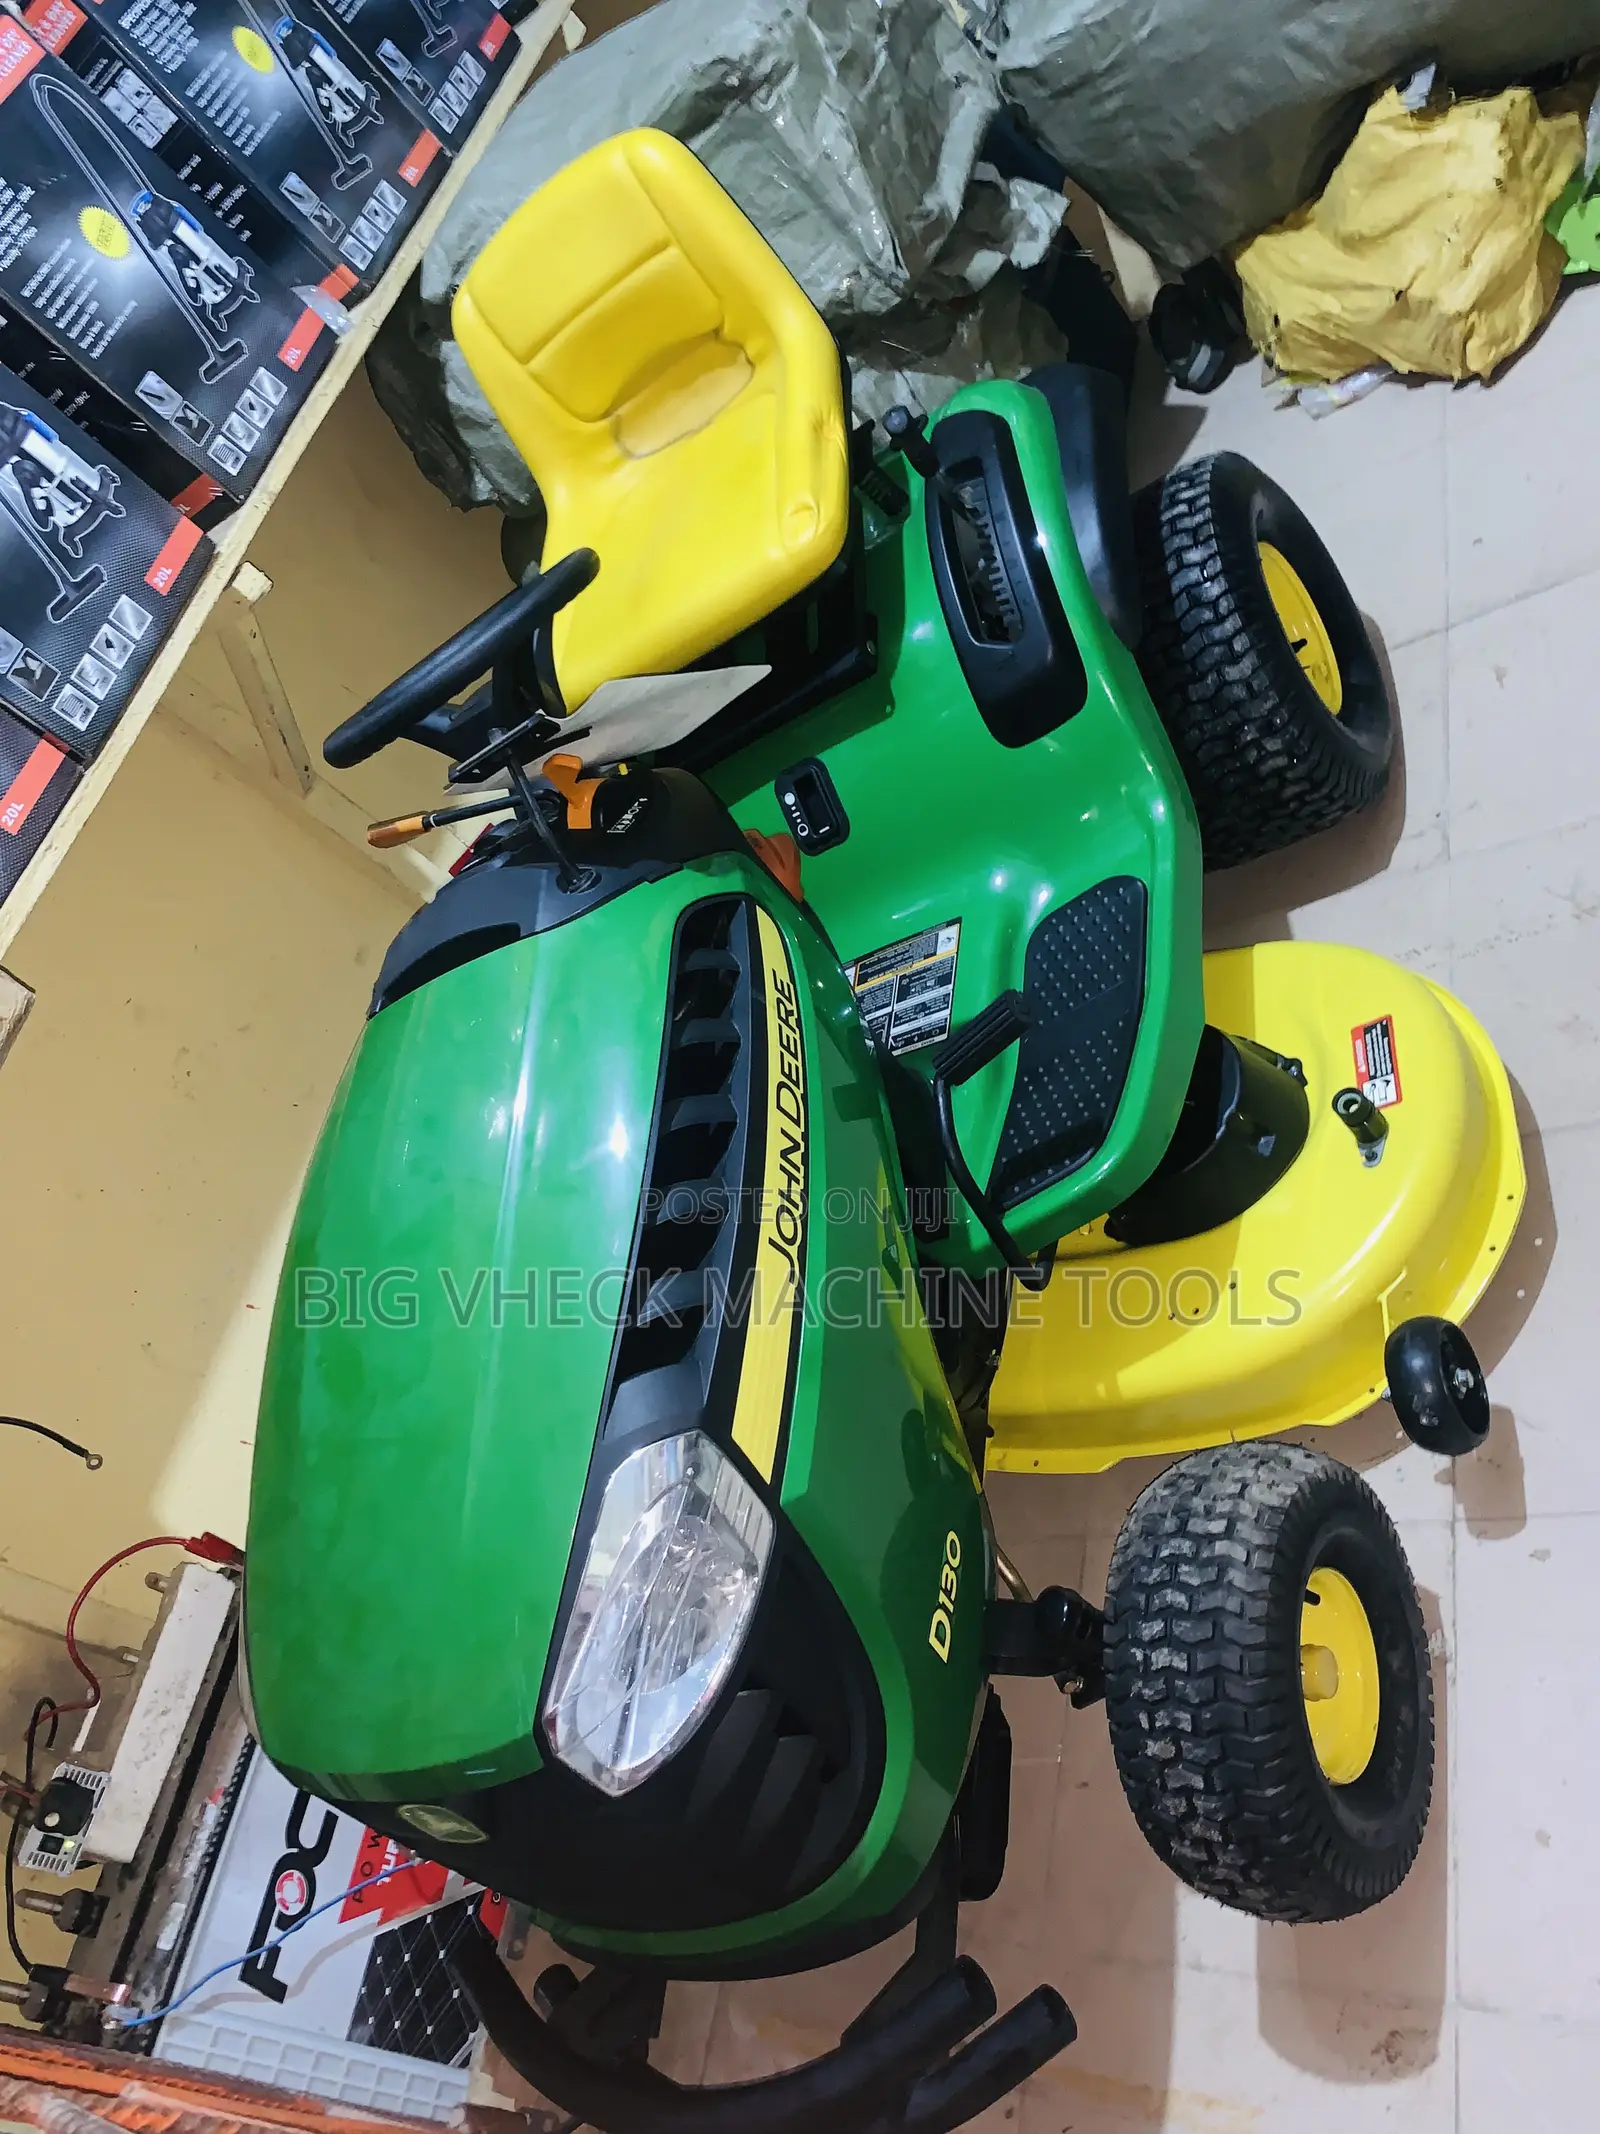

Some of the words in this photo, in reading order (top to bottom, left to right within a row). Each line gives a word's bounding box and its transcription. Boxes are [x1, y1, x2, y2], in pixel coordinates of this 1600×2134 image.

[153, 567, 172, 588] 20L
[2, 802, 24, 827] 20L
[772, 967, 802, 1130] DEERE
[768, 1128, 802, 1286] JOHN
[928, 1530, 961, 1664] D130
